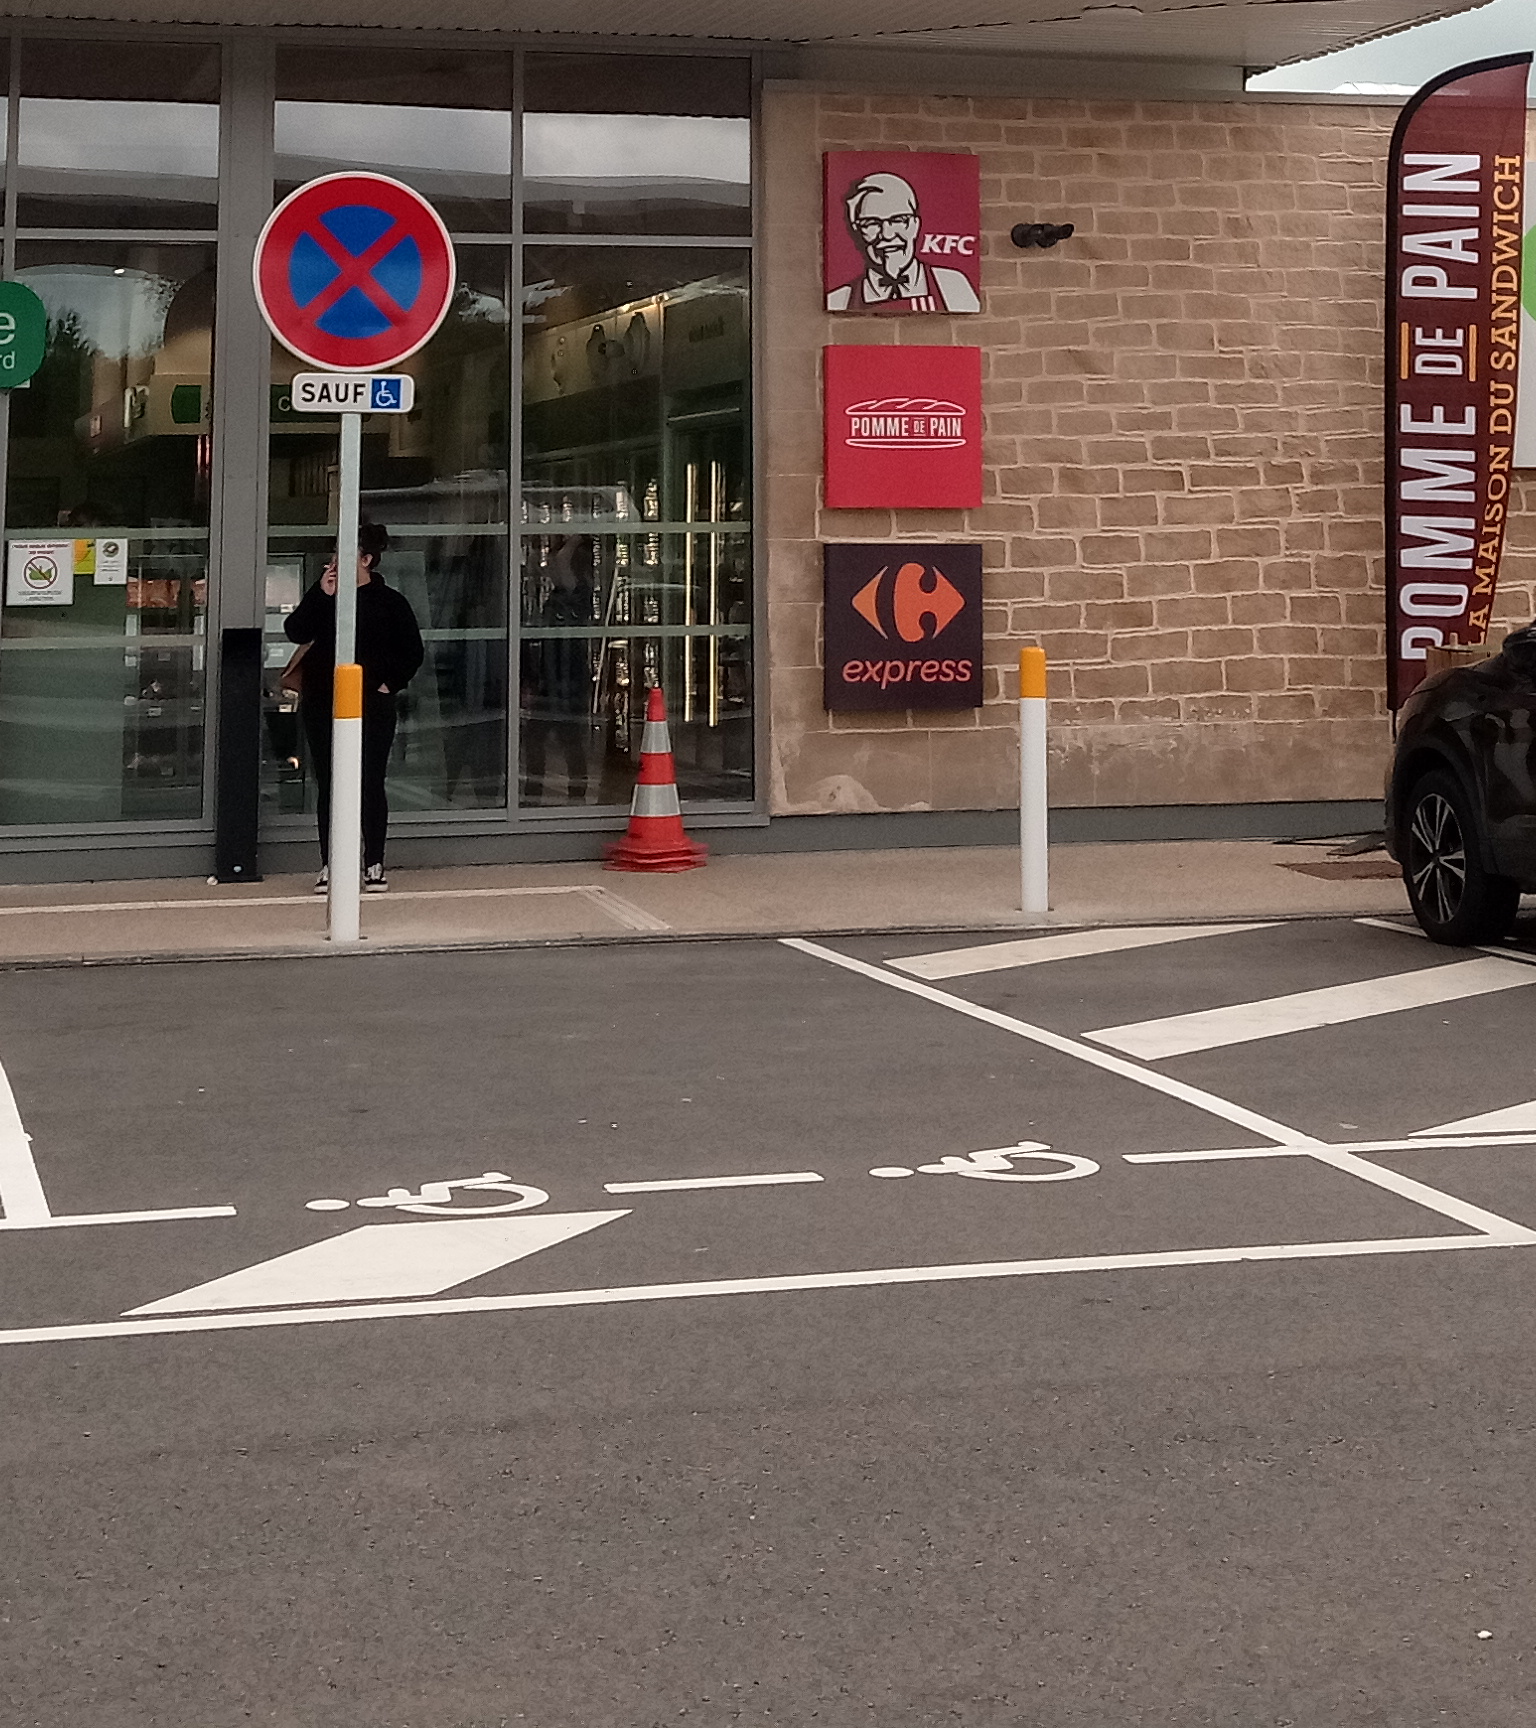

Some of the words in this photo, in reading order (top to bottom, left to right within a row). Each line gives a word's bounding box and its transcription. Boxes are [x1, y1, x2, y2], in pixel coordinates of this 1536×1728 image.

[920, 233, 976, 255] KFC
[1400, 153, 1481, 300] PAIN
[1490, 154, 1521, 371] SANDWICH
[1414, 327, 1463, 375] DE
[301, 382, 366, 404] SAUF
[1489, 379, 1515, 435] DU
[851, 417, 909, 437] POMME
[913, 420, 925, 433] DE
[930, 417, 961, 437] PAIN
[1399, 403, 1476, 660] POMME
[1471, 444, 1511, 597] MAISON
[1467, 603, 1489, 648] LA
[842, 659, 973, 690] express
